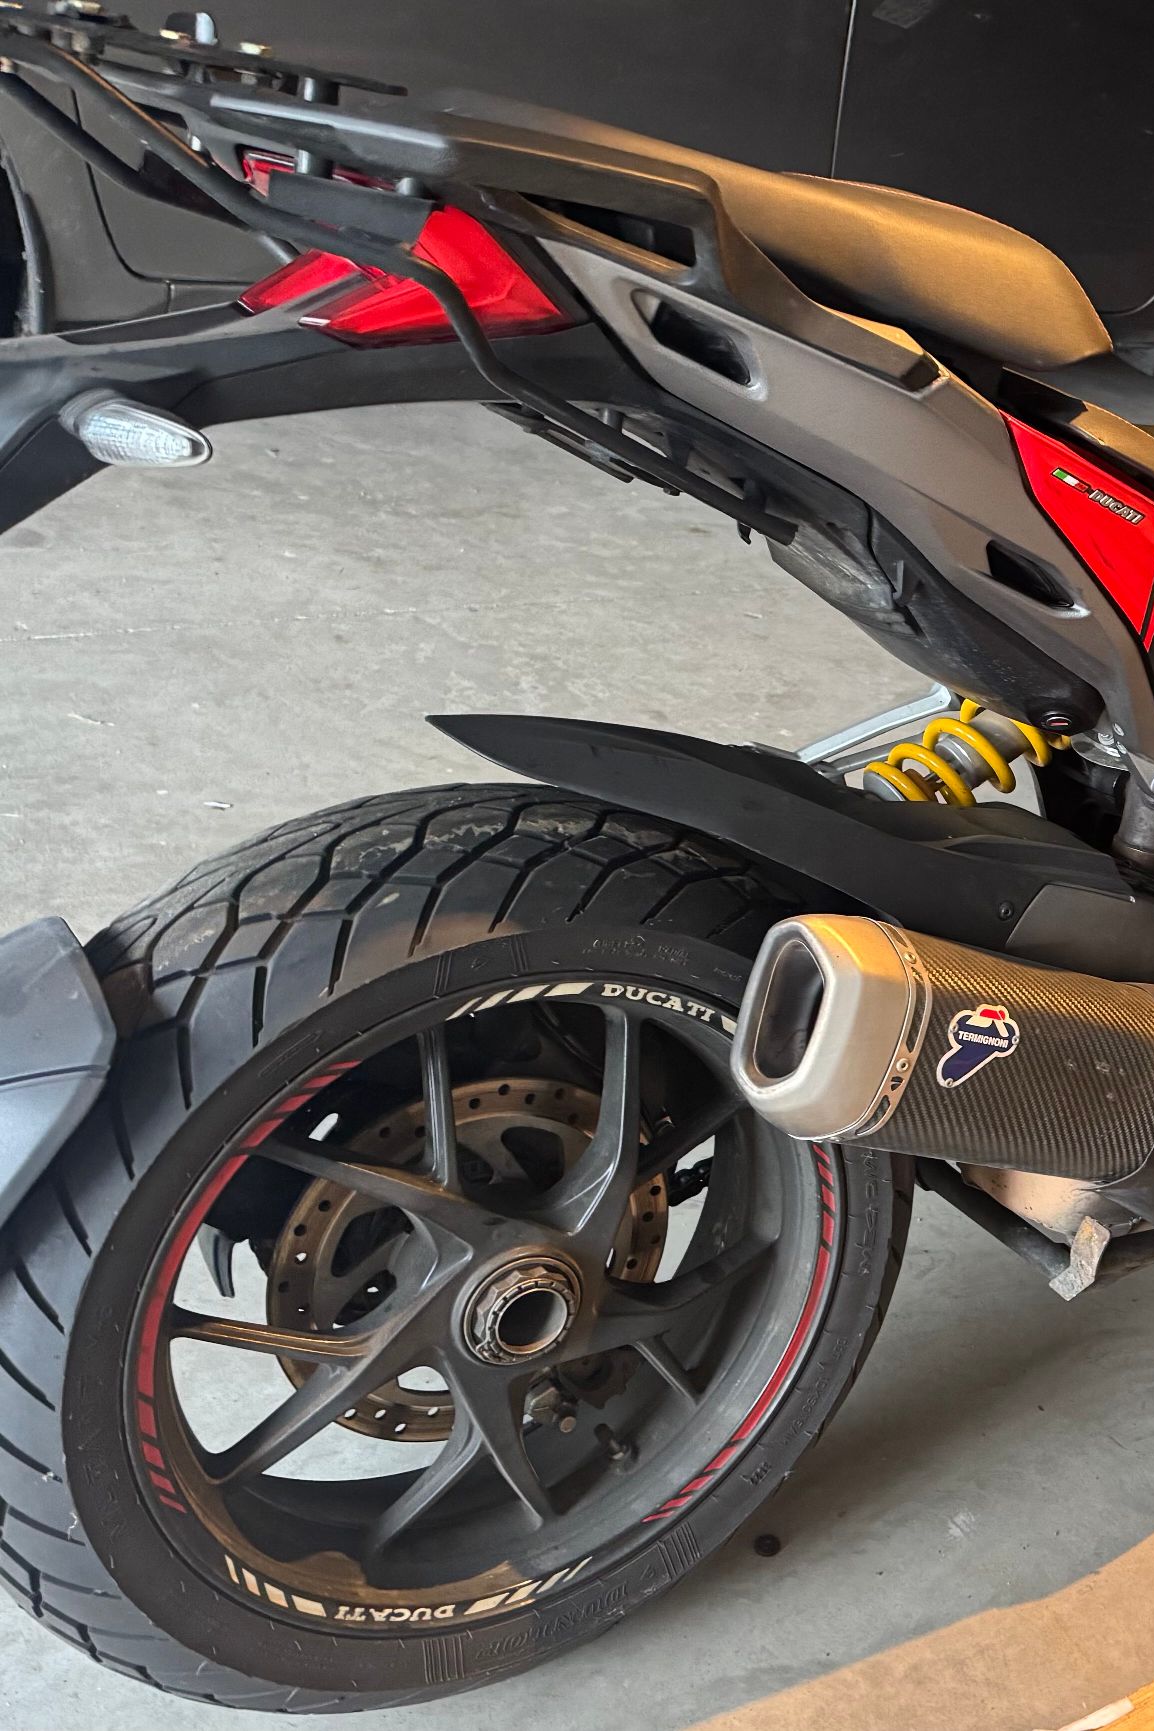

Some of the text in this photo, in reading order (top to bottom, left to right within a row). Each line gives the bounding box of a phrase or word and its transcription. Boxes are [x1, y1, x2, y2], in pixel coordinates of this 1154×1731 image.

[1088, 489, 1145, 525] DUCATI
[600, 983, 716, 1022] DUCATI
[958, 1030, 1009, 1049] TERMIGNONI
[333, 1603, 457, 1622] DUCATI
